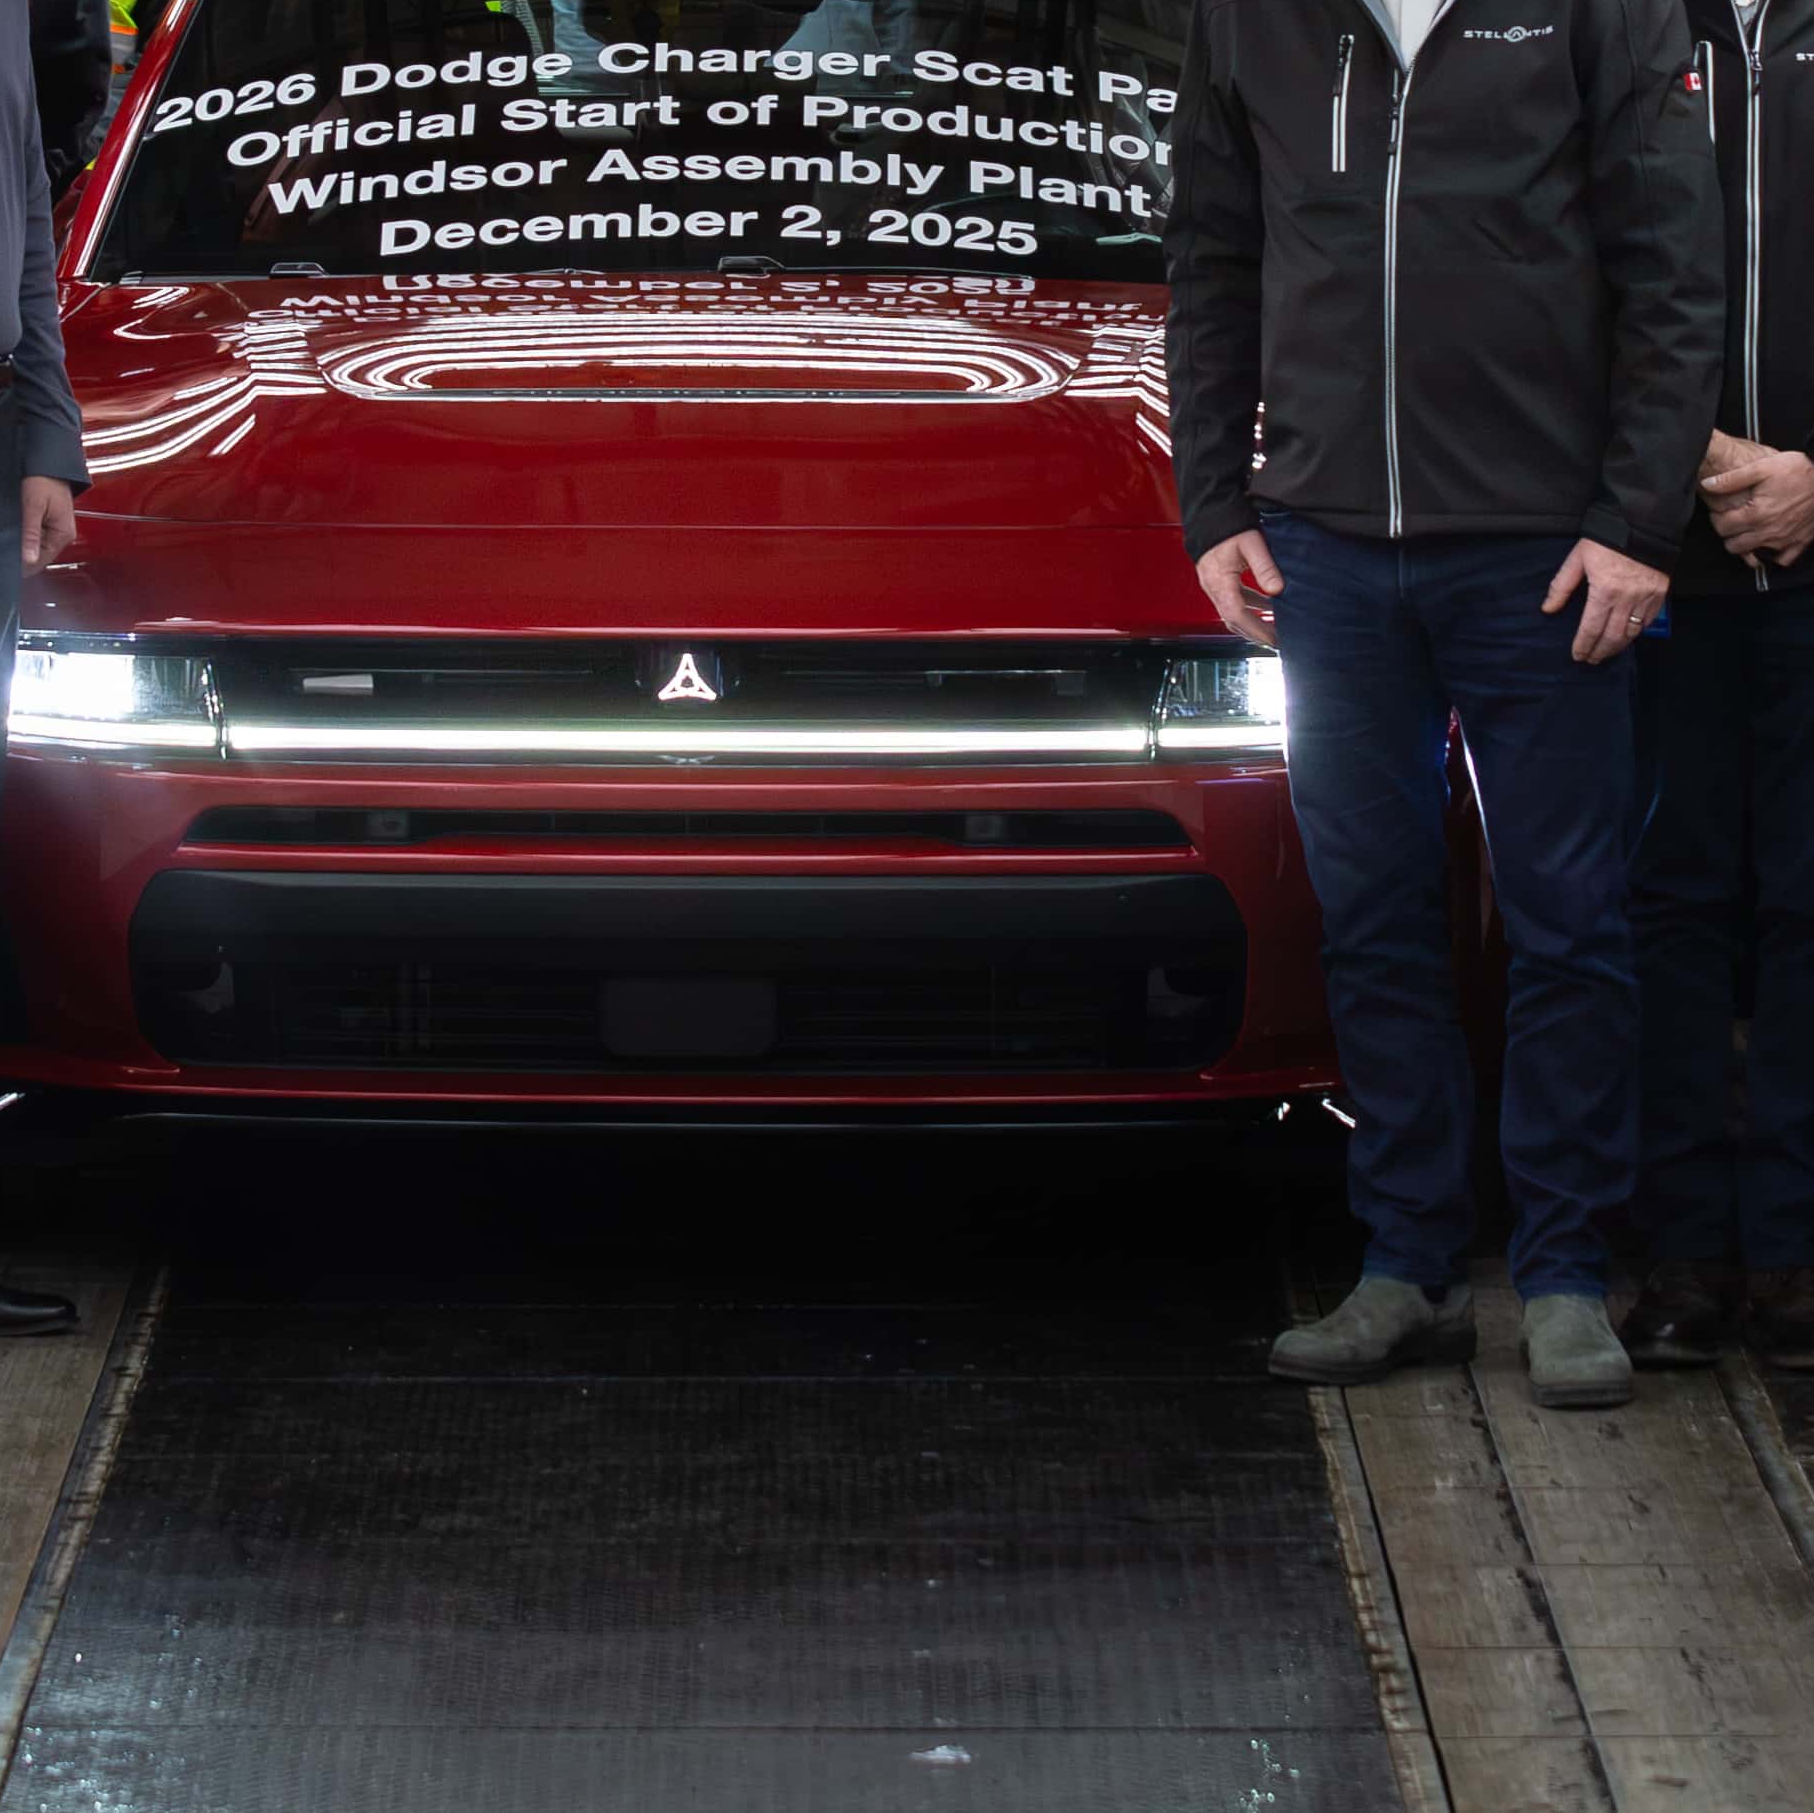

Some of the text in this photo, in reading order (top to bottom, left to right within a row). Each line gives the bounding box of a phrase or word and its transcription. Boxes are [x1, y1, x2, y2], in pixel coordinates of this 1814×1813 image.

[1462, 25, 1554, 44] STELLANTIS
[152, 42, 1178, 133] 2026 Dodge Charger Scat Pa
[226, 103, 476, 167] Official
[500, 95, 681, 132] Start
[706, 94, 779, 125] of
[267, 148, 1152, 218] Windsor Assembly Plant
[379, 203, 1038, 256] December 2, 2025
